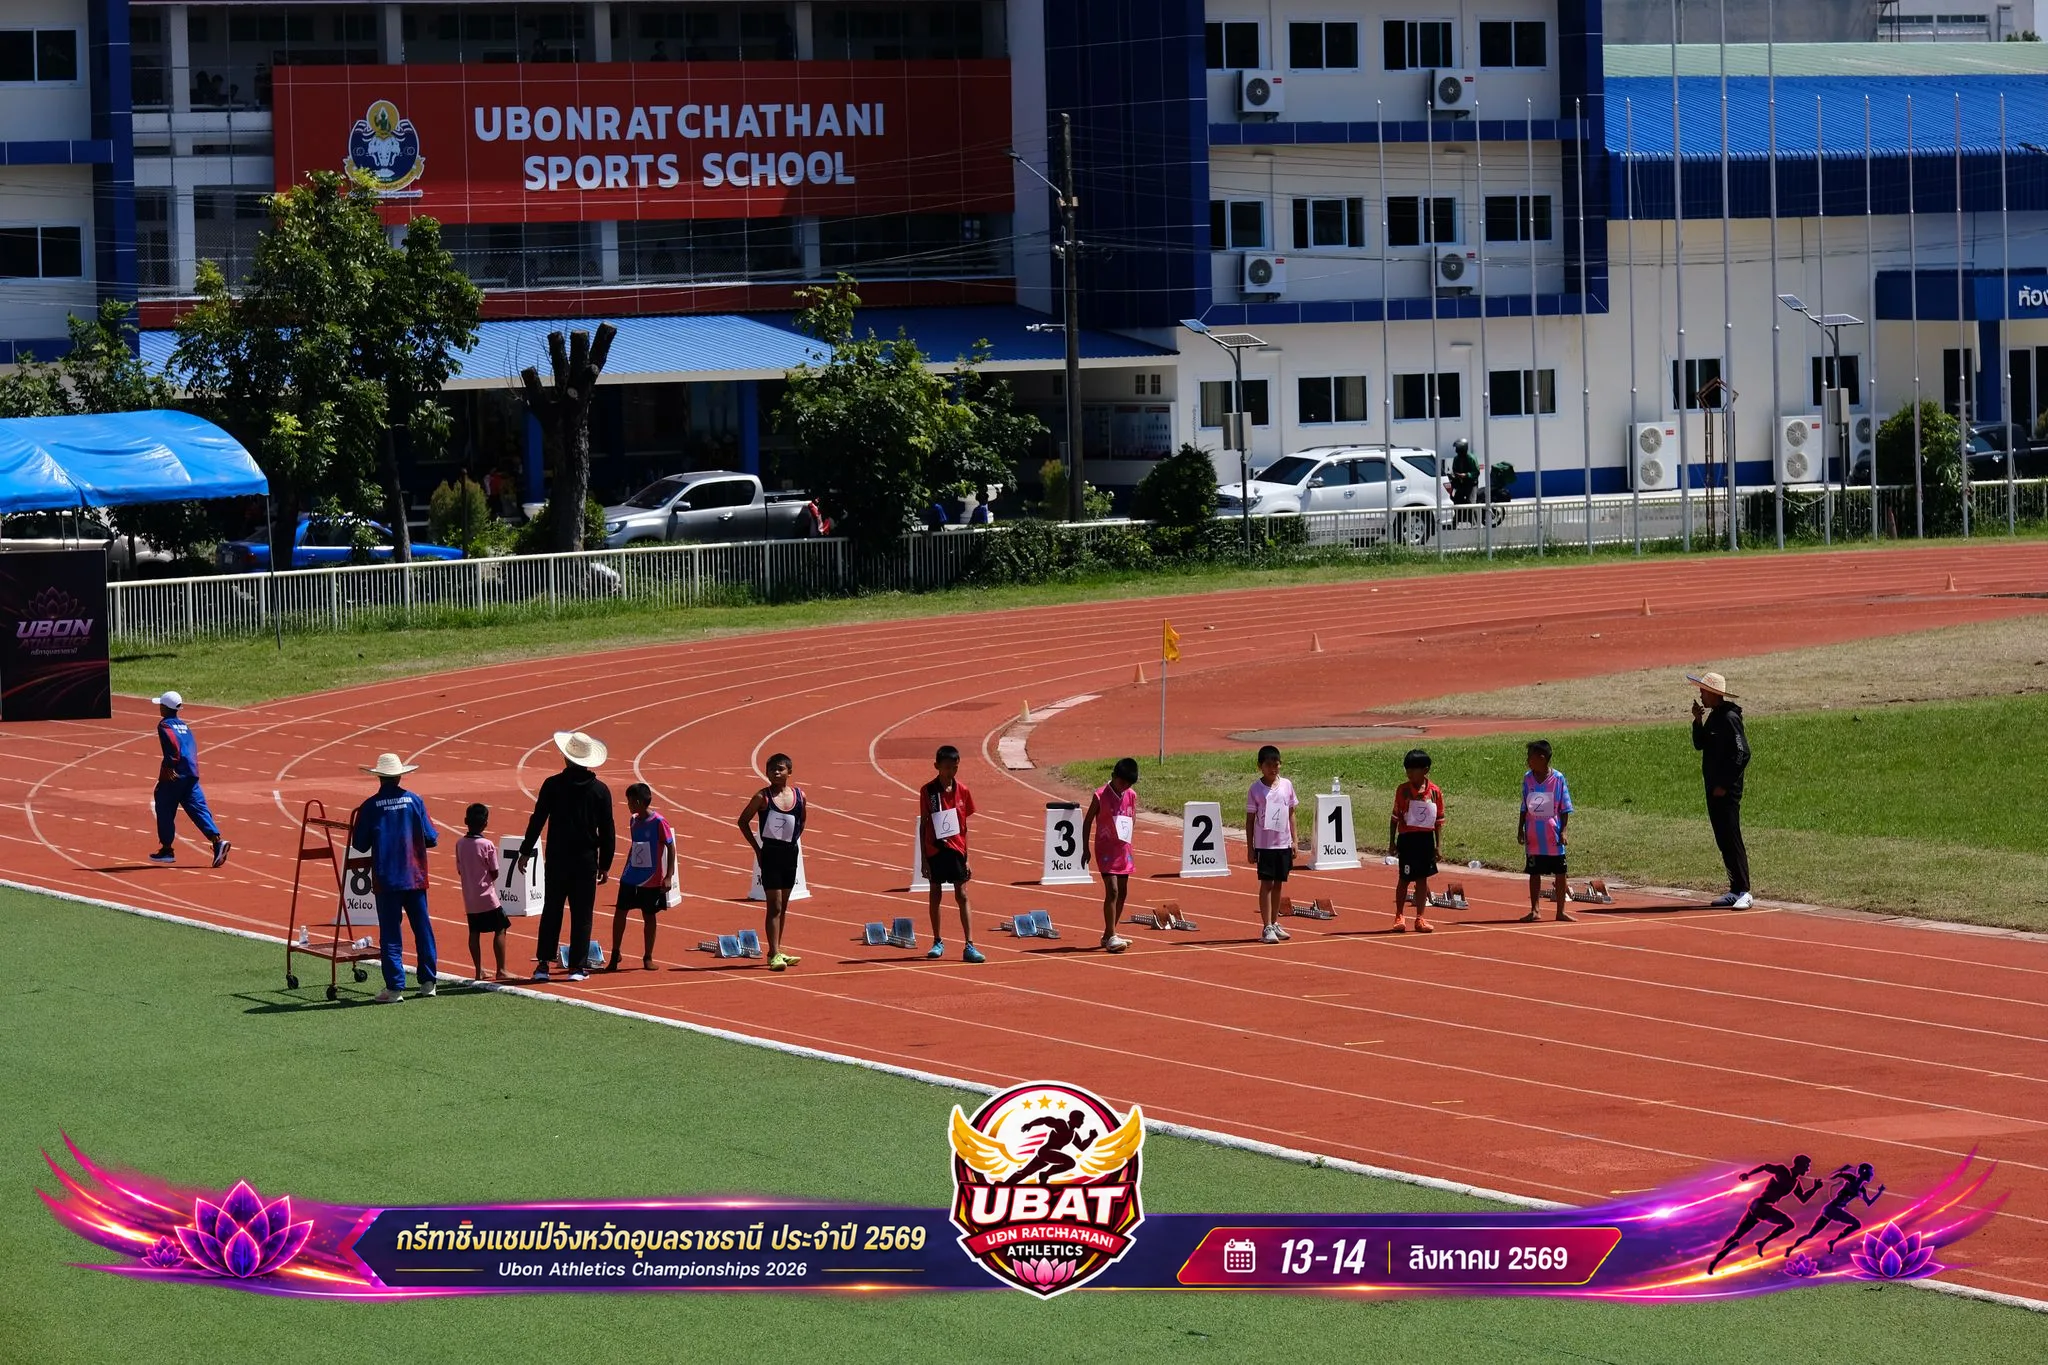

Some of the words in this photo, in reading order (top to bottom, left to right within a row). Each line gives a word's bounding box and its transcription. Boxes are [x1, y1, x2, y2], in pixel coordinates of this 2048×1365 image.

[474, 102, 885, 142] UBONRATCHATHANI
[524, 153, 680, 191] SPORTS
[702, 150, 855, 188] SCHOOL
[16, 619, 93, 638] UBON
[1416, 806, 1427, 822] 3
[1533, 796, 1545, 812] 2
[941, 812, 951, 832] 6
[1271, 808, 1281, 824] 4
[1327, 805, 1343, 843] 1
[1054, 820, 1076, 857] 3
[1120, 820, 1130, 840] 5
[1191, 814, 1215, 851] 2
[1190, 854, 1216, 865] Nelco
[1323, 844, 1346, 855] Nelco
[503, 849, 520, 888] 7
[350, 866, 372, 896] 8
[347, 898, 373, 910] Nelco
